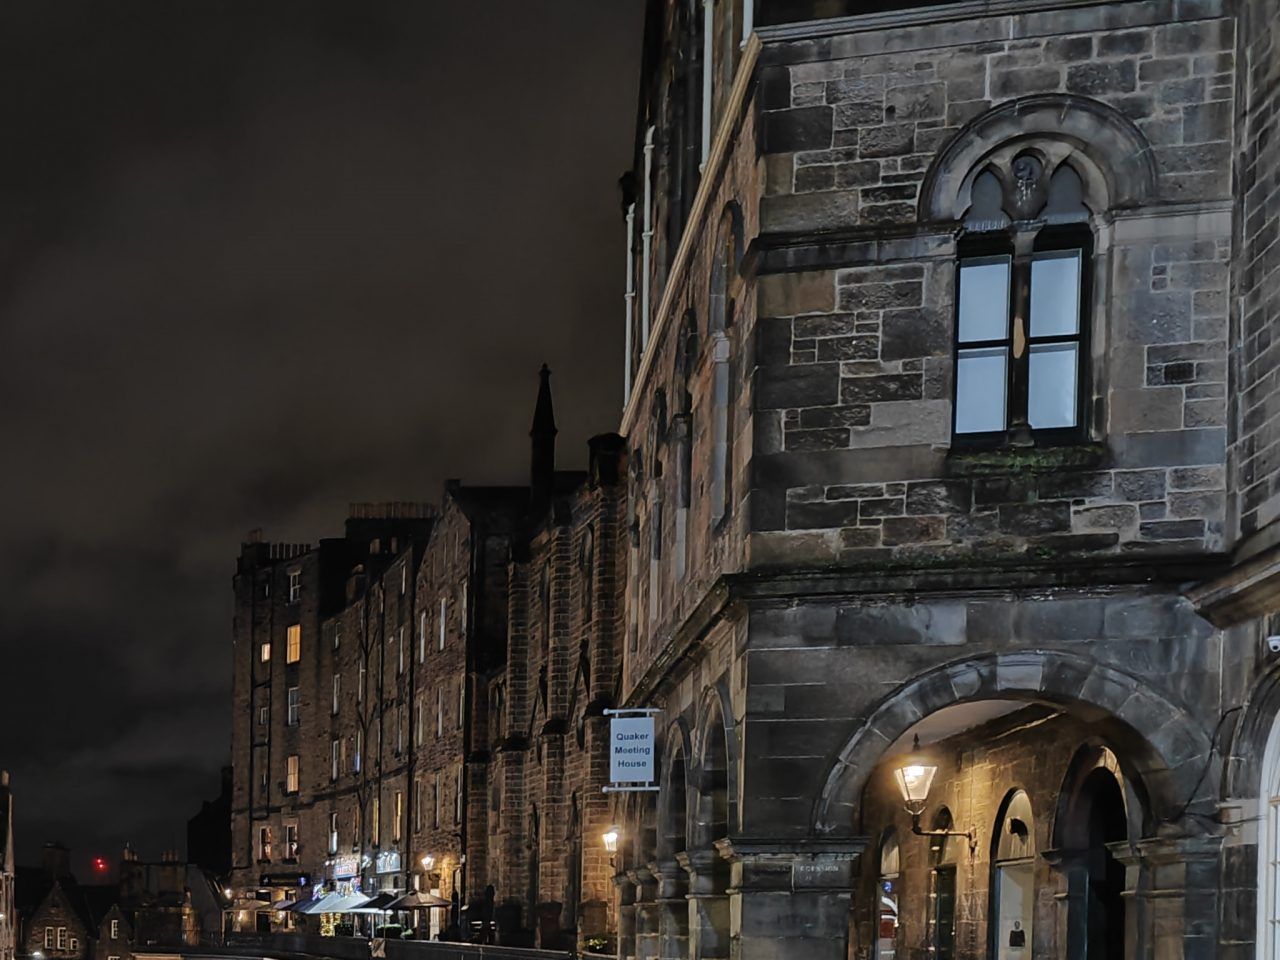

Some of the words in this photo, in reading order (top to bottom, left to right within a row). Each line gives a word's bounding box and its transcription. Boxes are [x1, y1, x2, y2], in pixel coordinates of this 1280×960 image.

[616, 732, 649, 741] Quaker
[615, 745, 651, 755] Meeting
[618, 760, 647, 768] House
